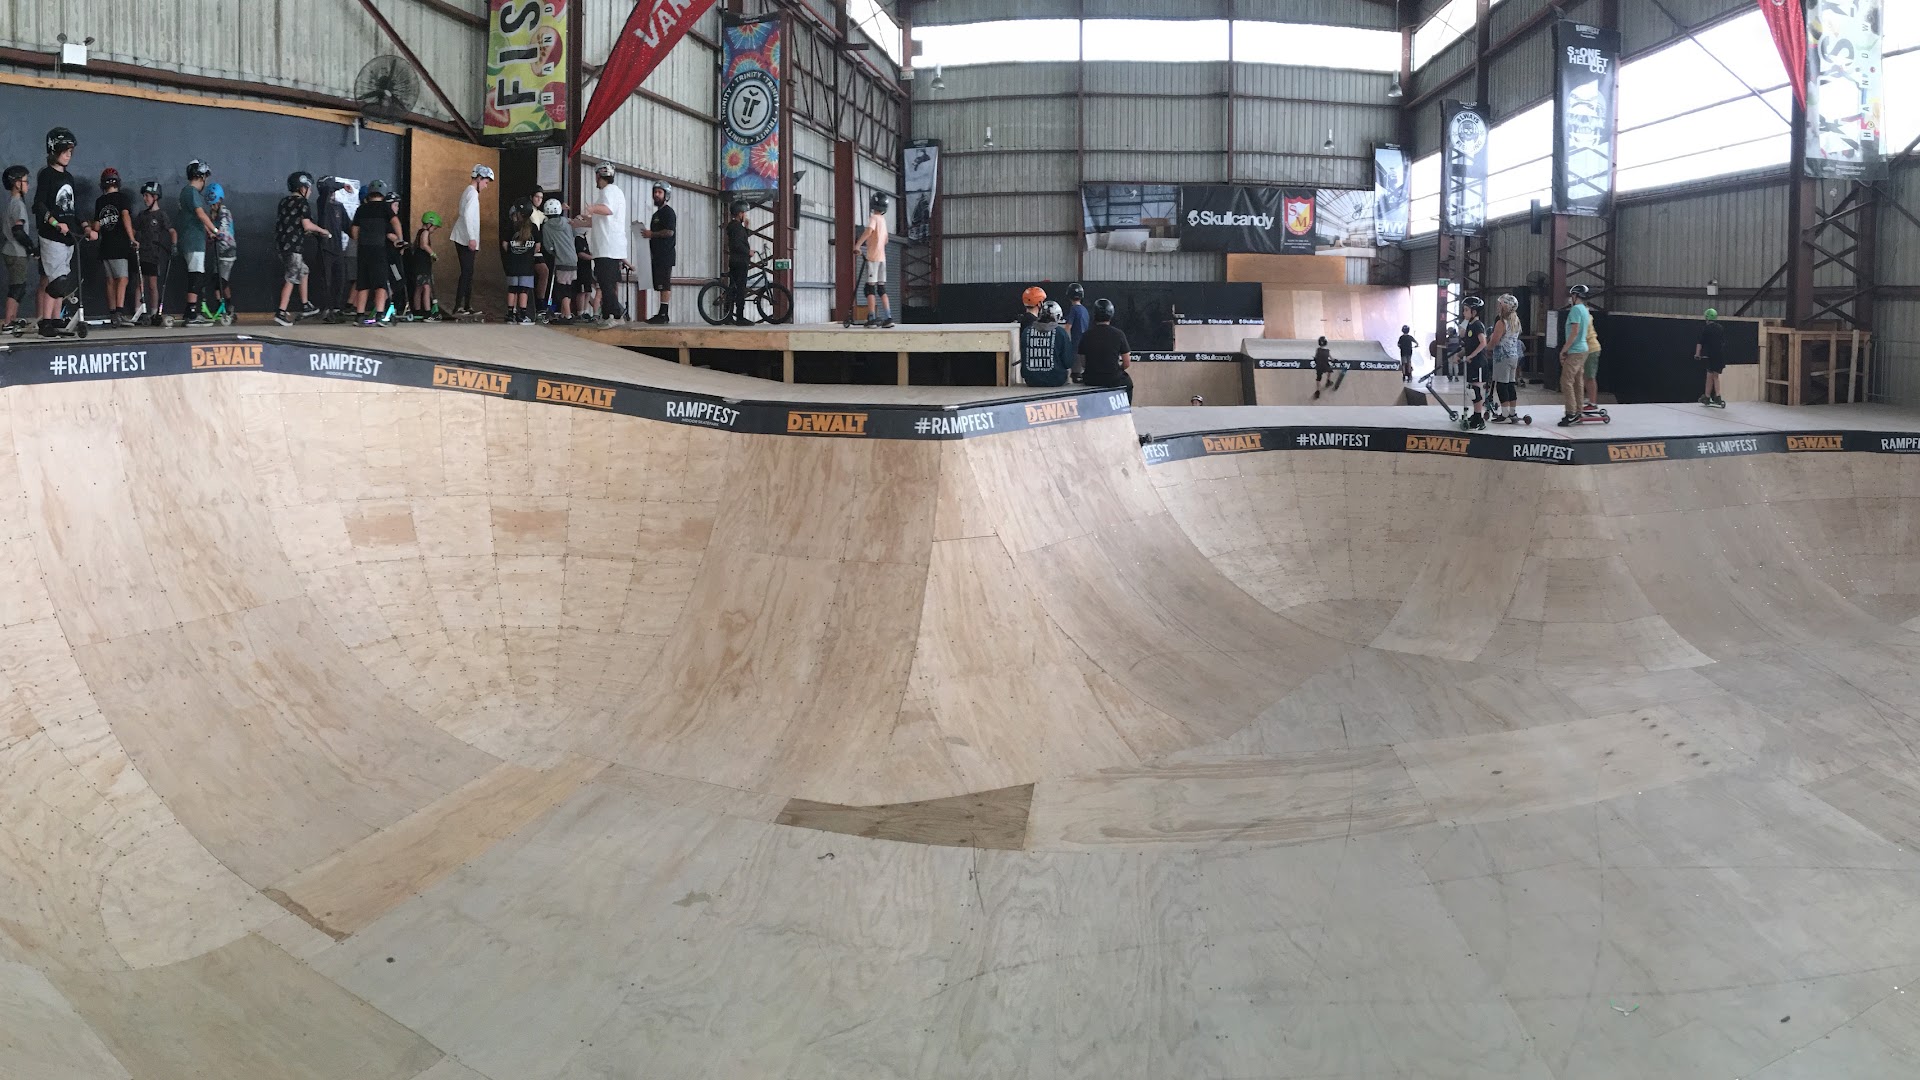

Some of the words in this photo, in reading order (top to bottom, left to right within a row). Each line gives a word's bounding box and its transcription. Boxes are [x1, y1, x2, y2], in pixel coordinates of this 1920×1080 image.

[1569, 55, 1608, 67] HELMET
[734, 71, 762, 82] TRINITY
[1589, 64, 1606, 74] CO.
[764, 77, 780, 107] TRINITY
[722, 87, 731, 119] TRINITY
[1457, 113, 1480, 123] ALWAYS
[725, 127, 748, 144] TRINITY
[756, 117, 777, 142] TRINITY
[1200, 211, 1274, 230] Skullcandy
[1377, 221, 1404, 234] ENVY
[1030, 338, 1050, 347] QUEENS
[50, 351, 147, 375] #RAMPFEST
[309, 353, 383, 376] RAMPFEST
[1201, 353, 1233, 361] Skullcandy
[1265, 360, 1300, 368] Skullcandy
[1366, 362, 1400, 370] Skullcandy
[666, 401, 740, 426] RAMPFEST
[914, 412, 995, 435] #RAMPFEST
[1296, 432, 1370, 447] #RAMPFEST
[1697, 438, 1758, 454] #RAMPFEST
[1881, 437, 1920, 450] RAMPF
[1513, 444, 1575, 461] RAMPFEST
